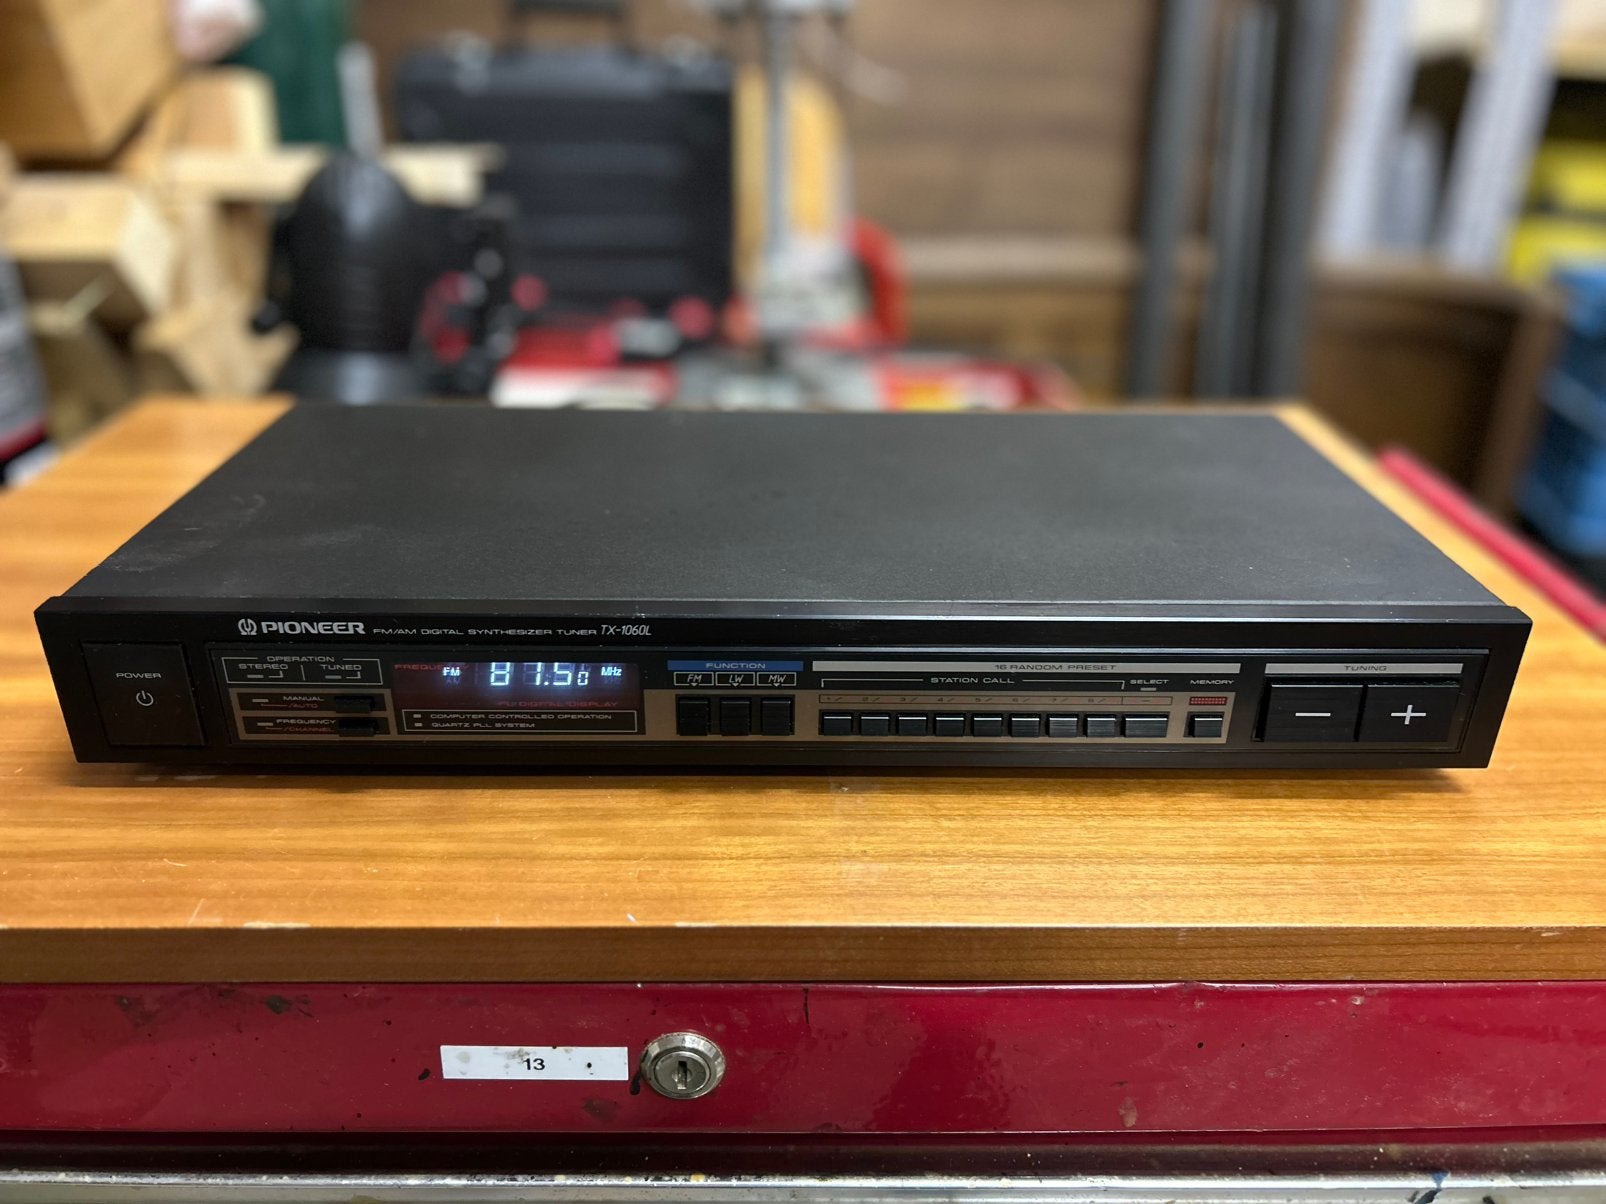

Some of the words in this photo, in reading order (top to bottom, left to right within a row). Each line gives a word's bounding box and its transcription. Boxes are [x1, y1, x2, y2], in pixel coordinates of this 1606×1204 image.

[261, 621, 366, 634] PIONEER
[468, 628, 552, 636] SYNTHESIZER
[601, 624, 652, 636] TX-1060L
[442, 666, 461, 676] FM
[601, 666, 623, 676] MHz
[687, 674, 702, 683] FM
[729, 674, 744, 683] LW
[768, 674, 787, 683] MW
[524, 1058, 546, 1071] 13
